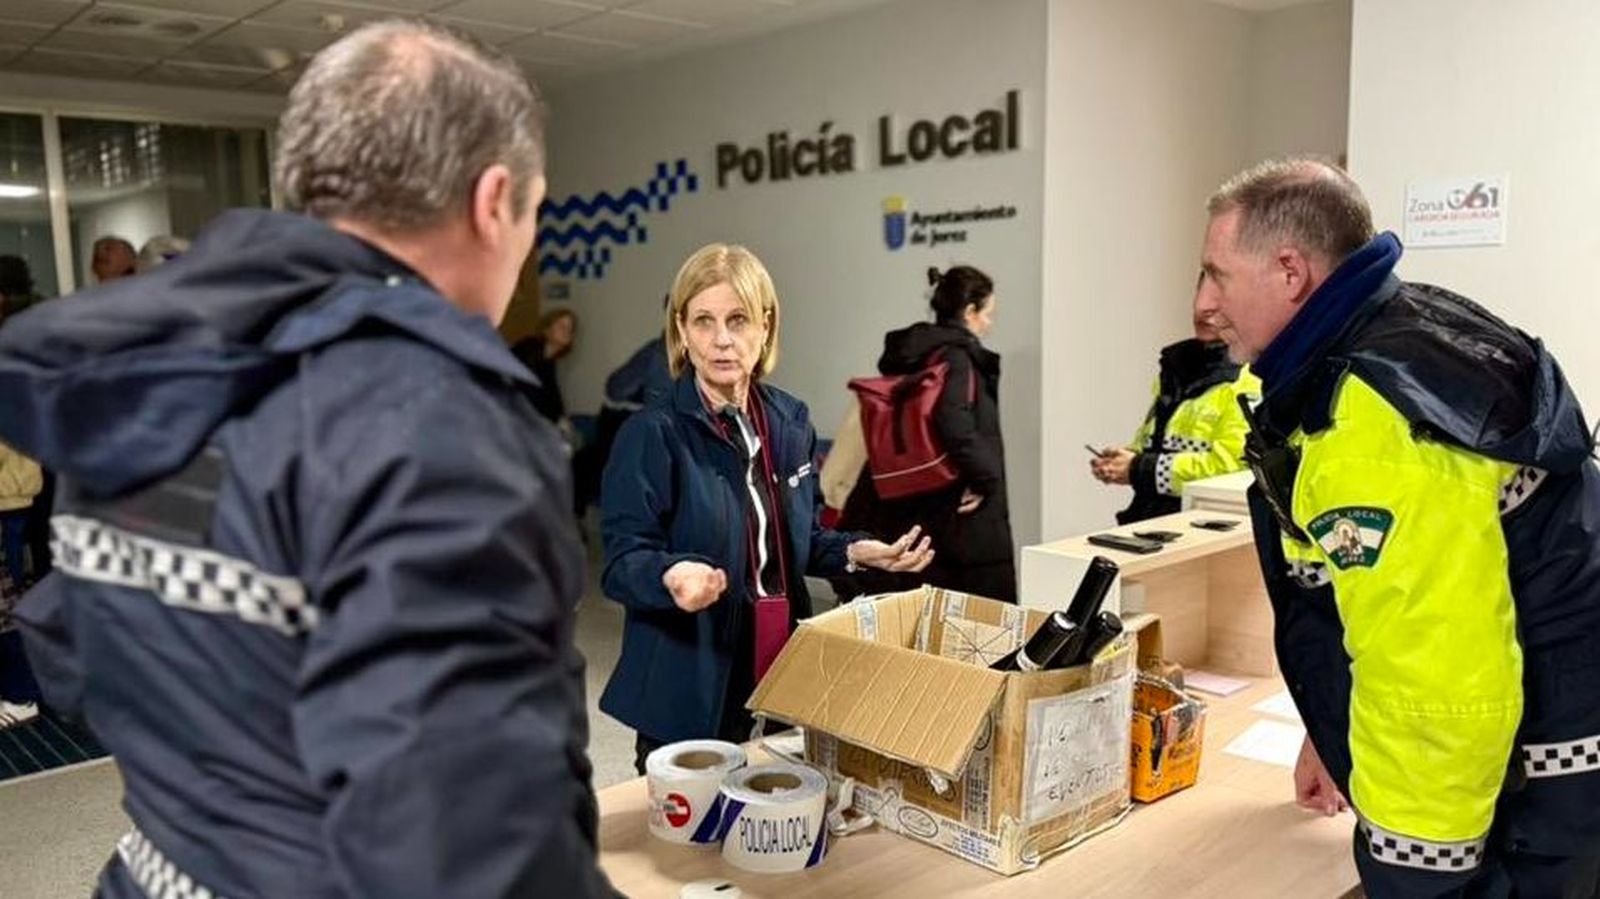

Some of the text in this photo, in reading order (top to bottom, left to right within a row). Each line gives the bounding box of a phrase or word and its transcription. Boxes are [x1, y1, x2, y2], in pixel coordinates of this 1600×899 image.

[716, 90, 1019, 189] Policía Local
[911, 205, 1016, 227] Ayuntamiento
[1408, 198, 1444, 213] Zona
[911, 229, 926, 244] de
[781, 815, 812, 852] LOCAL
